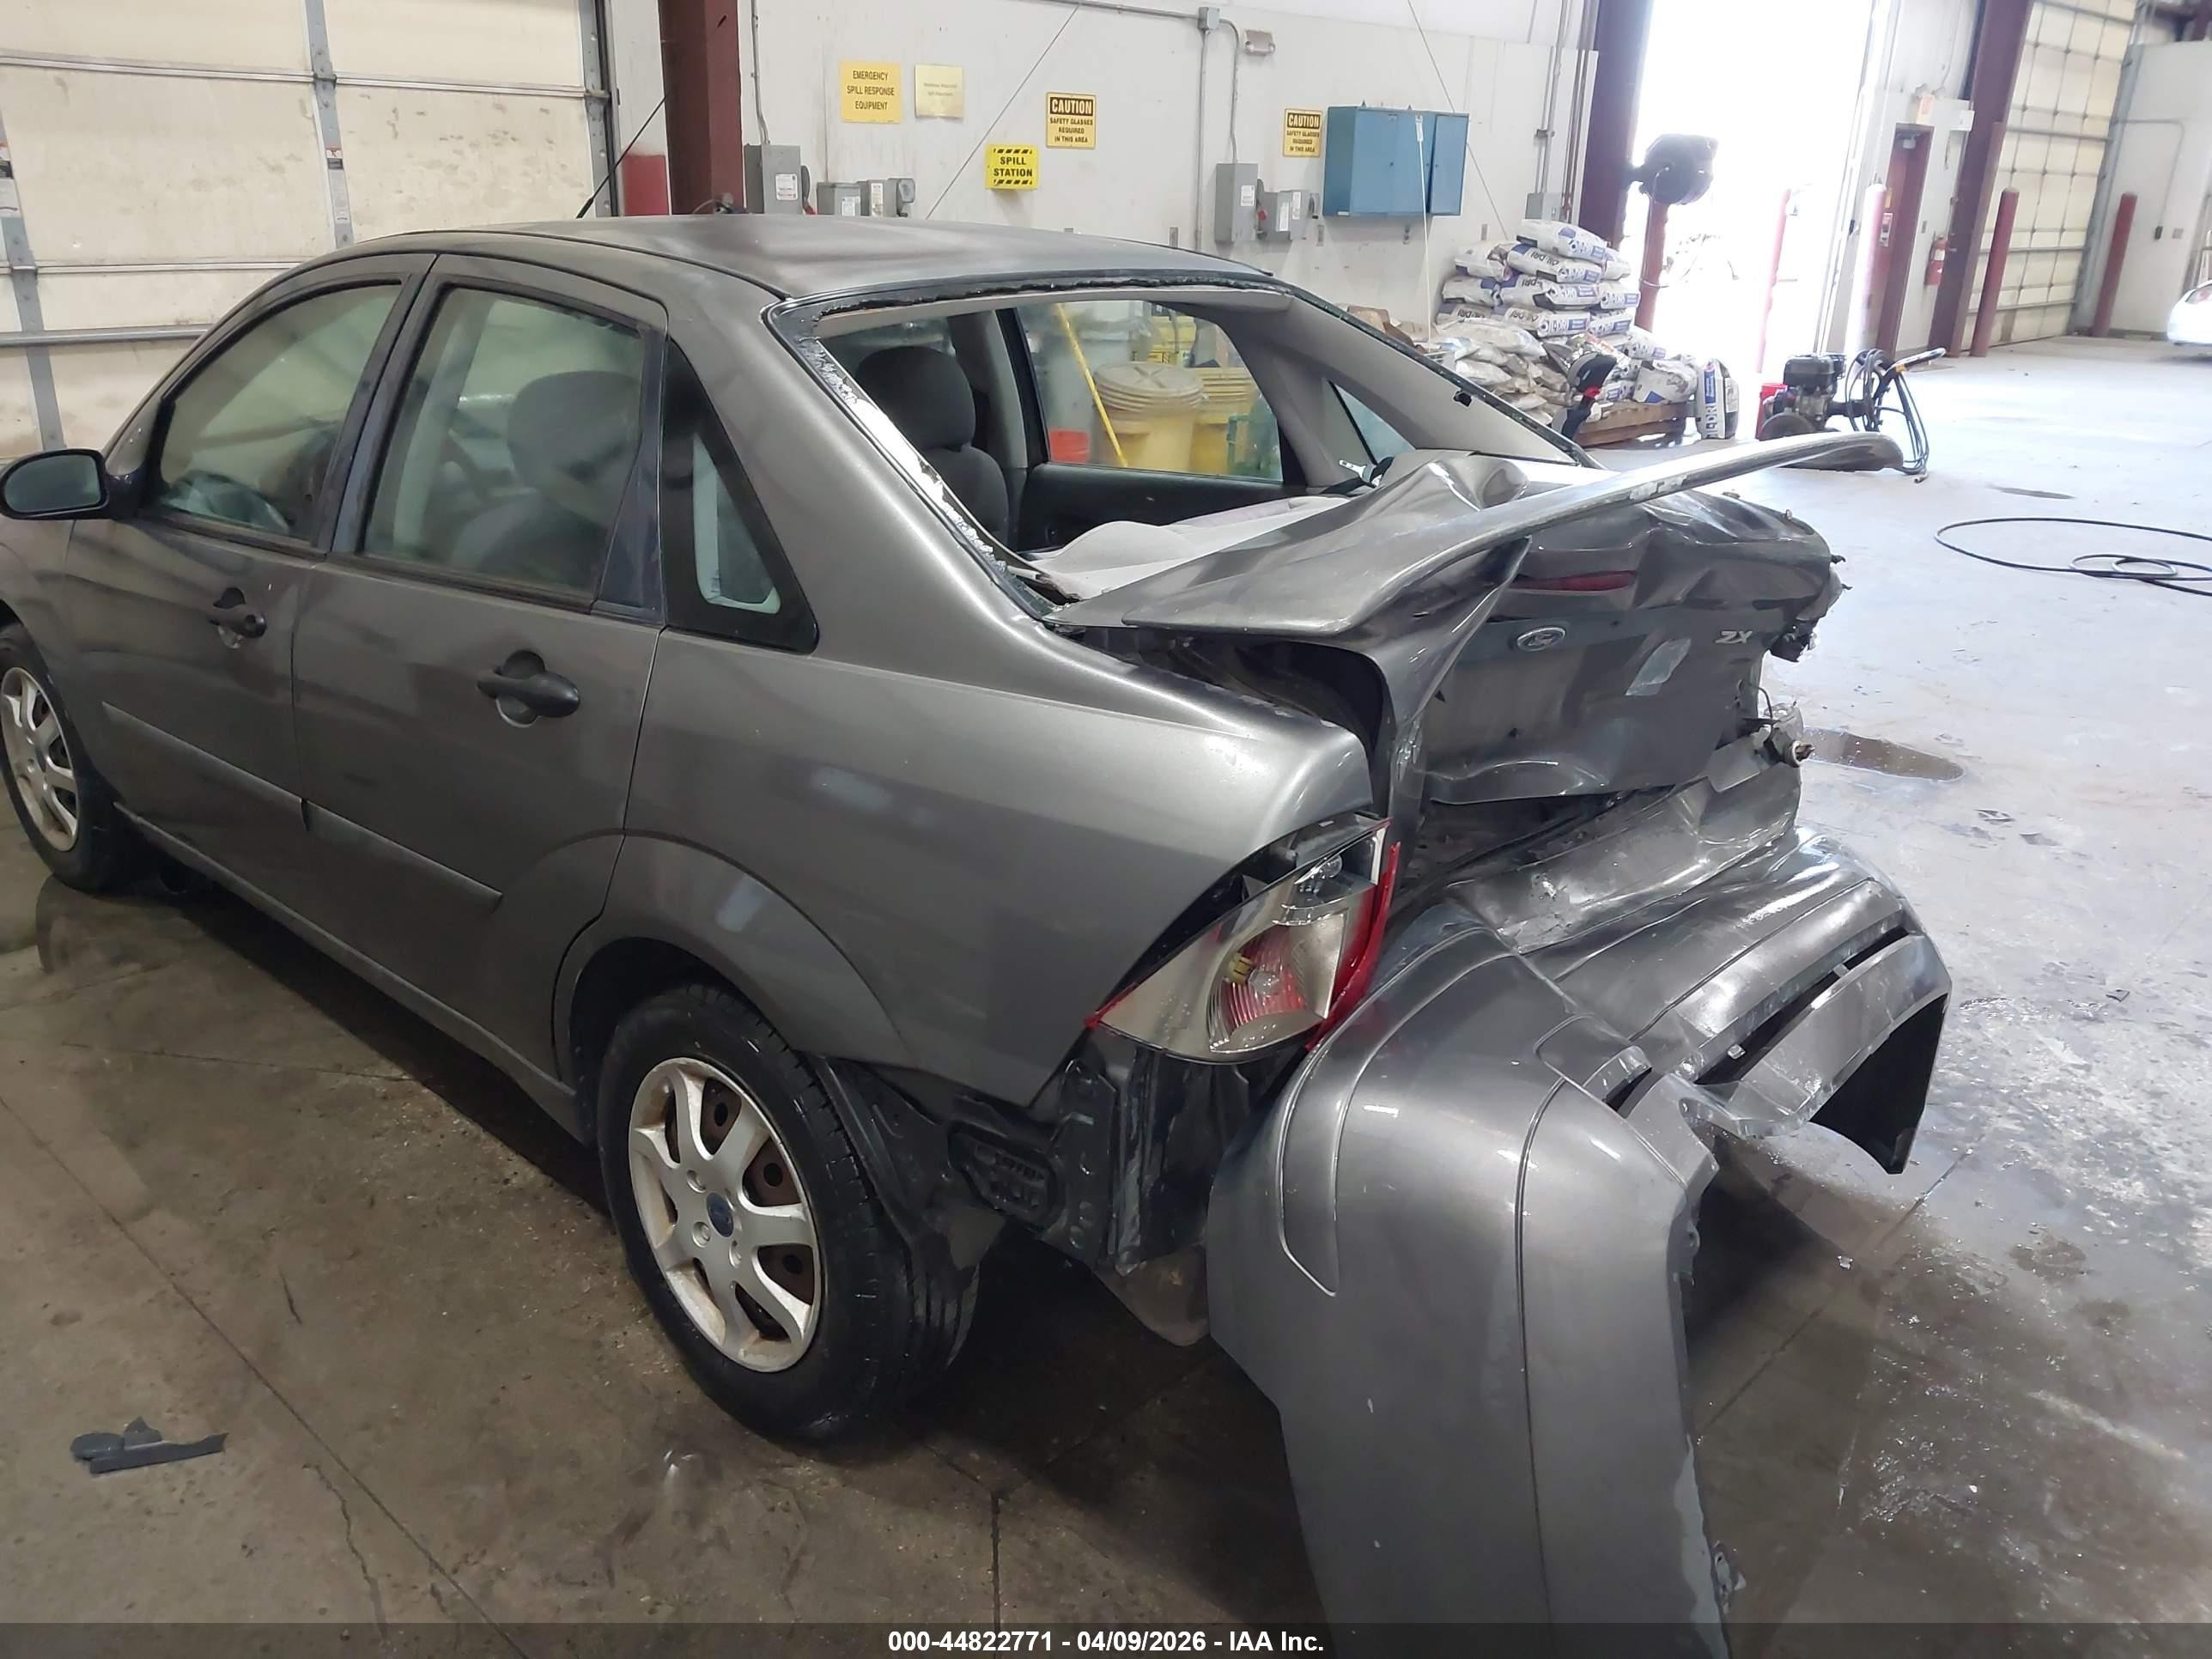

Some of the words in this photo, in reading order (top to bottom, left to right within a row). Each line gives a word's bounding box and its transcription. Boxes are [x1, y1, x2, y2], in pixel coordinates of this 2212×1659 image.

[853, 70, 888, 81] EMERGENCY
[847, 85, 863, 94] SPILL
[865, 87, 895, 96] RESPONSE
[855, 100, 888, 111] EQUIPMENT
[1051, 99, 1092, 114] CAUTION
[1050, 117, 1069, 125] SAFETY
[1289, 114, 1319, 127] CAUTION
[1000, 156, 1026, 165] SPILL
[994, 167, 1033, 177] STATION
